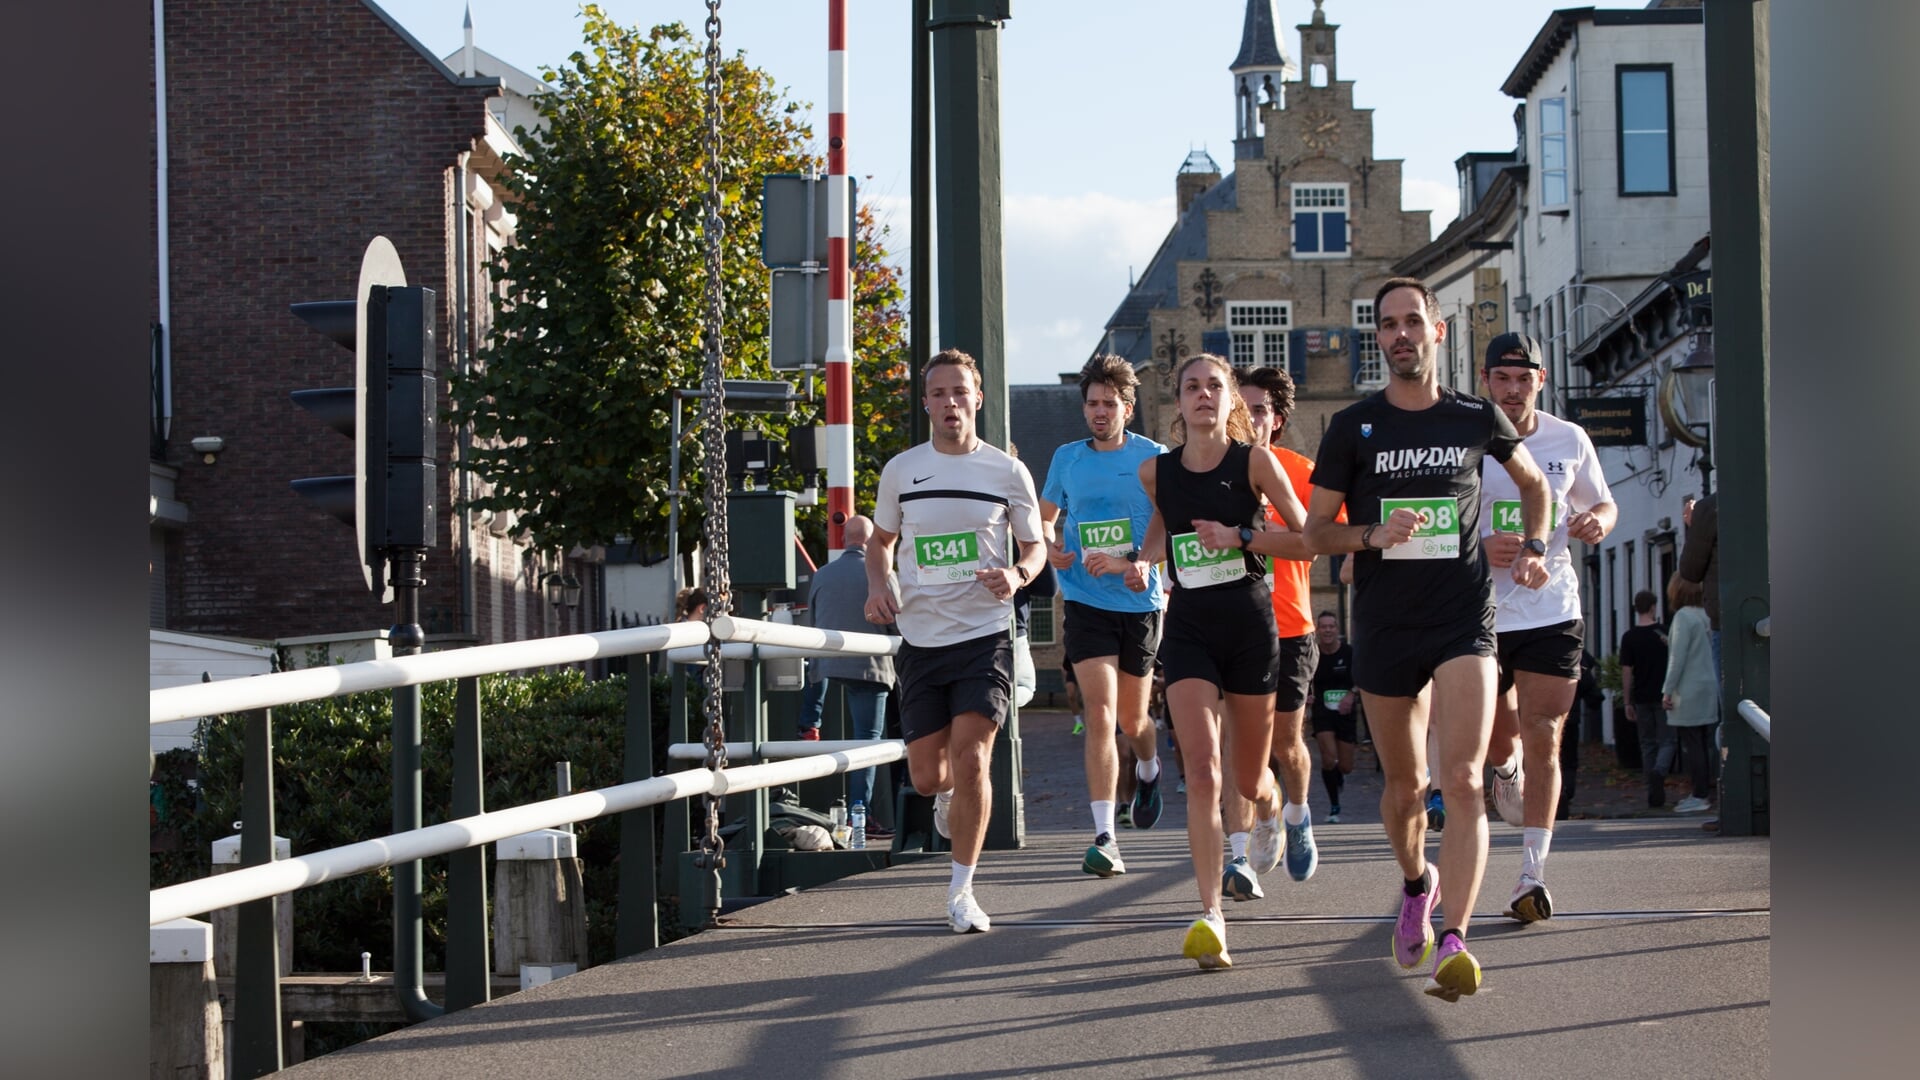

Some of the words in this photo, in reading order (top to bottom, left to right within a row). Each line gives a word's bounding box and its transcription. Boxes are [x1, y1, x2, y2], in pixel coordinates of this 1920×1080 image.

[1686, 281, 1703, 299] De
[1375, 446, 1469, 474] RUN2DAY
[1085, 525, 1124, 544] 1170
[922, 538, 968, 561] 1341
[1440, 543, 1458, 553] kpn
[1226, 567, 1245, 577] kpn
